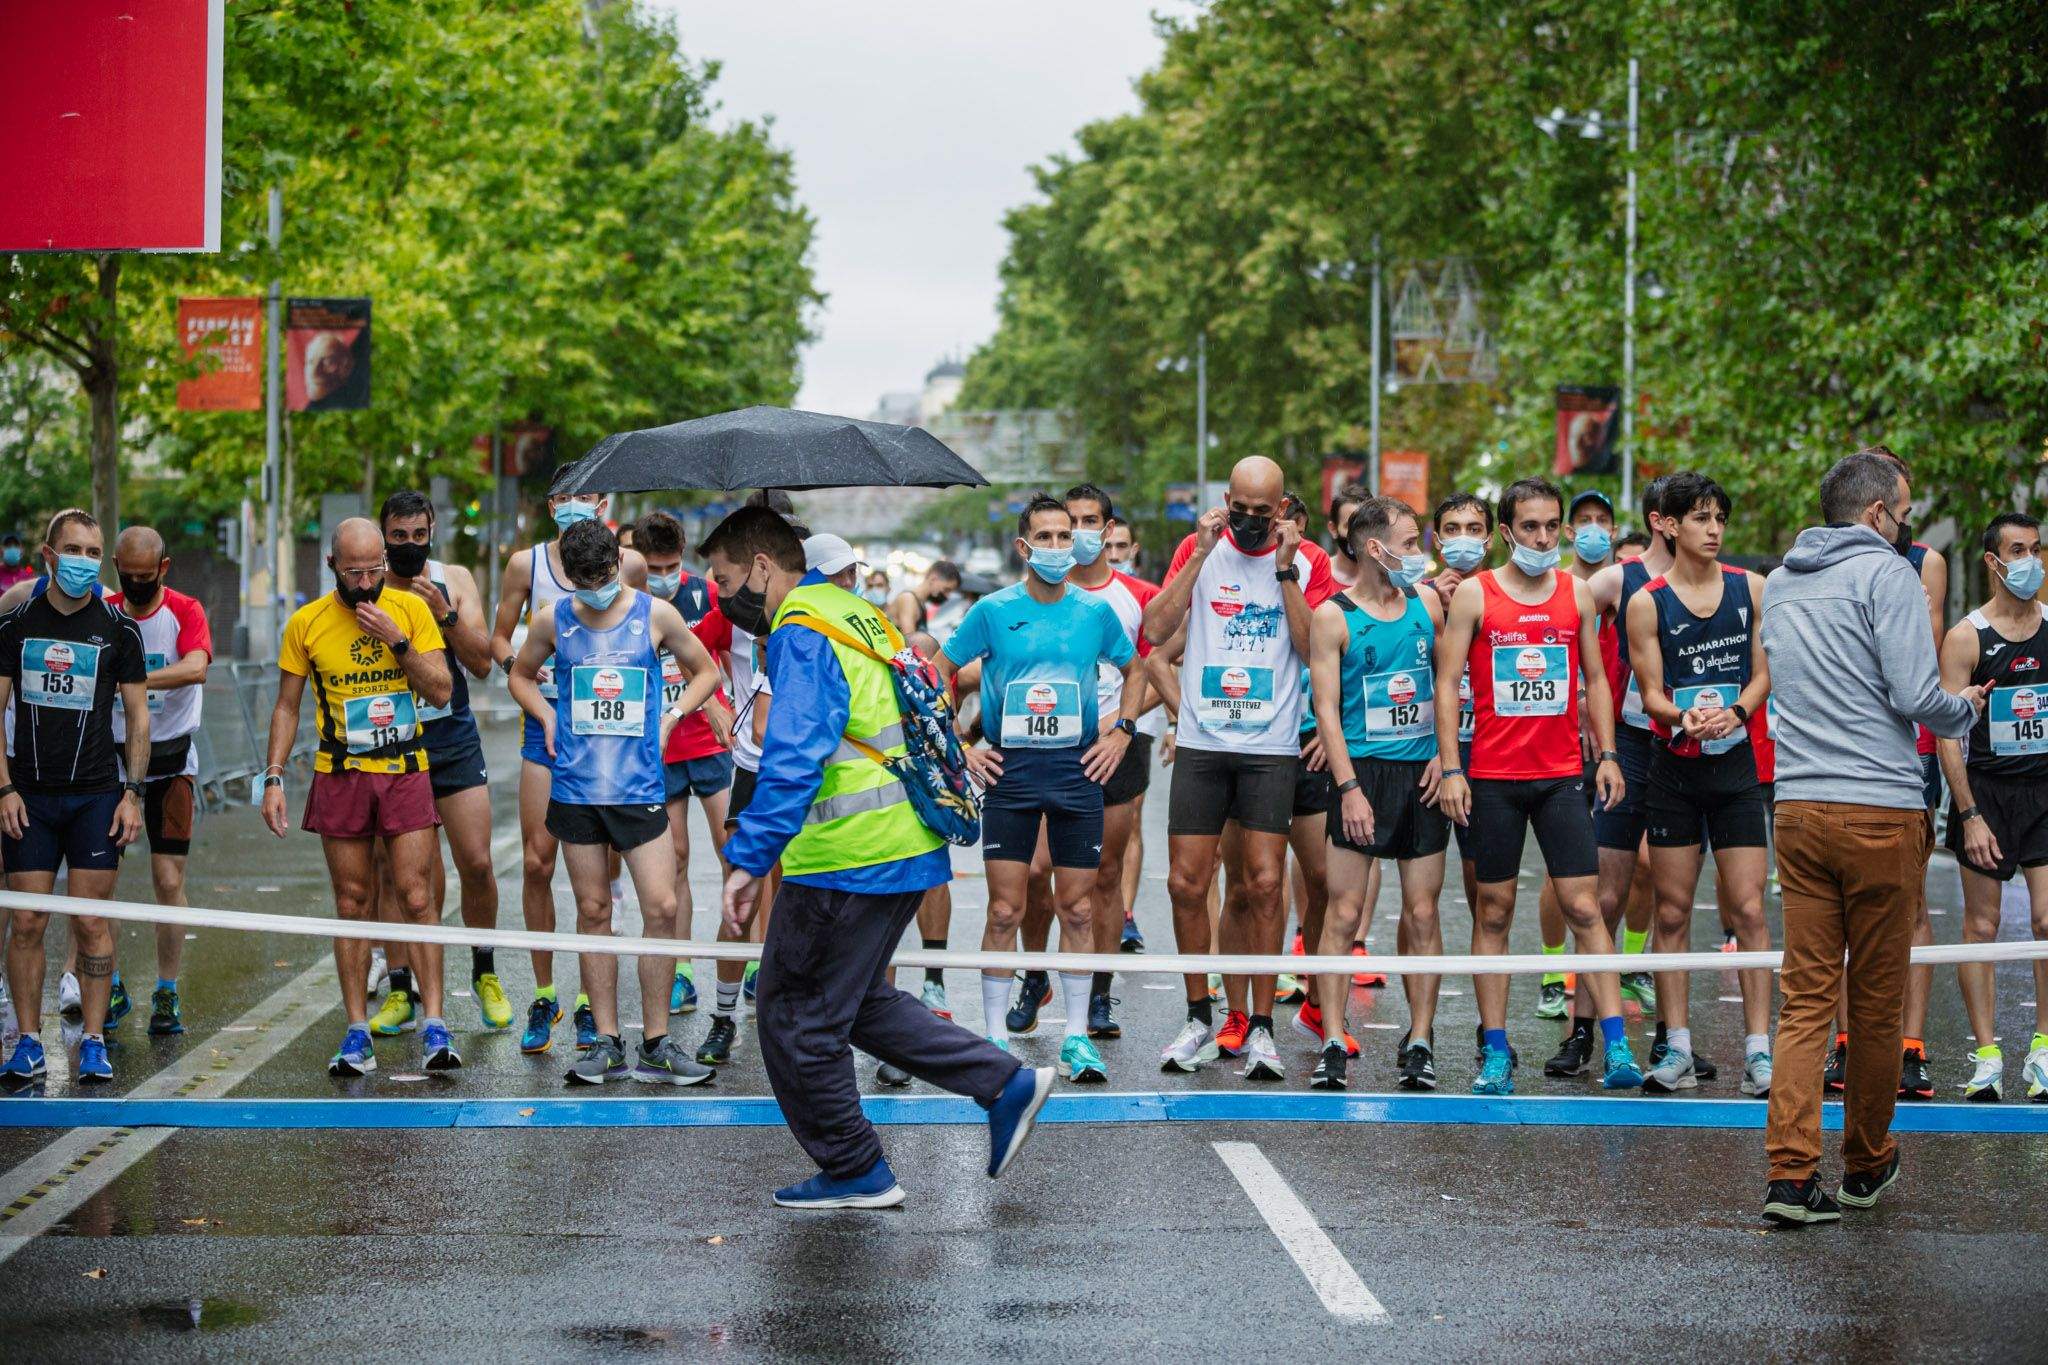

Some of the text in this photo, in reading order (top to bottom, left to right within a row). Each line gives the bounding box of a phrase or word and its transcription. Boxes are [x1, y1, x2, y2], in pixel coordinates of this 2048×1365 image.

[1497, 632, 1528, 643] califas
[1706, 652, 1740, 670] alquiber
[41, 672, 74, 695] 153
[352, 684, 389, 695] SPORTS
[1510, 681, 1556, 702] 1253
[591, 700, 625, 721] 138
[1211, 700, 1232, 709] REYES
[1229, 709, 1242, 720] 36
[1024, 715, 1059, 737] 148
[1388, 704, 1419, 727] 152
[370, 726, 399, 749] 113
[2011, 719, 2044, 742] 145
